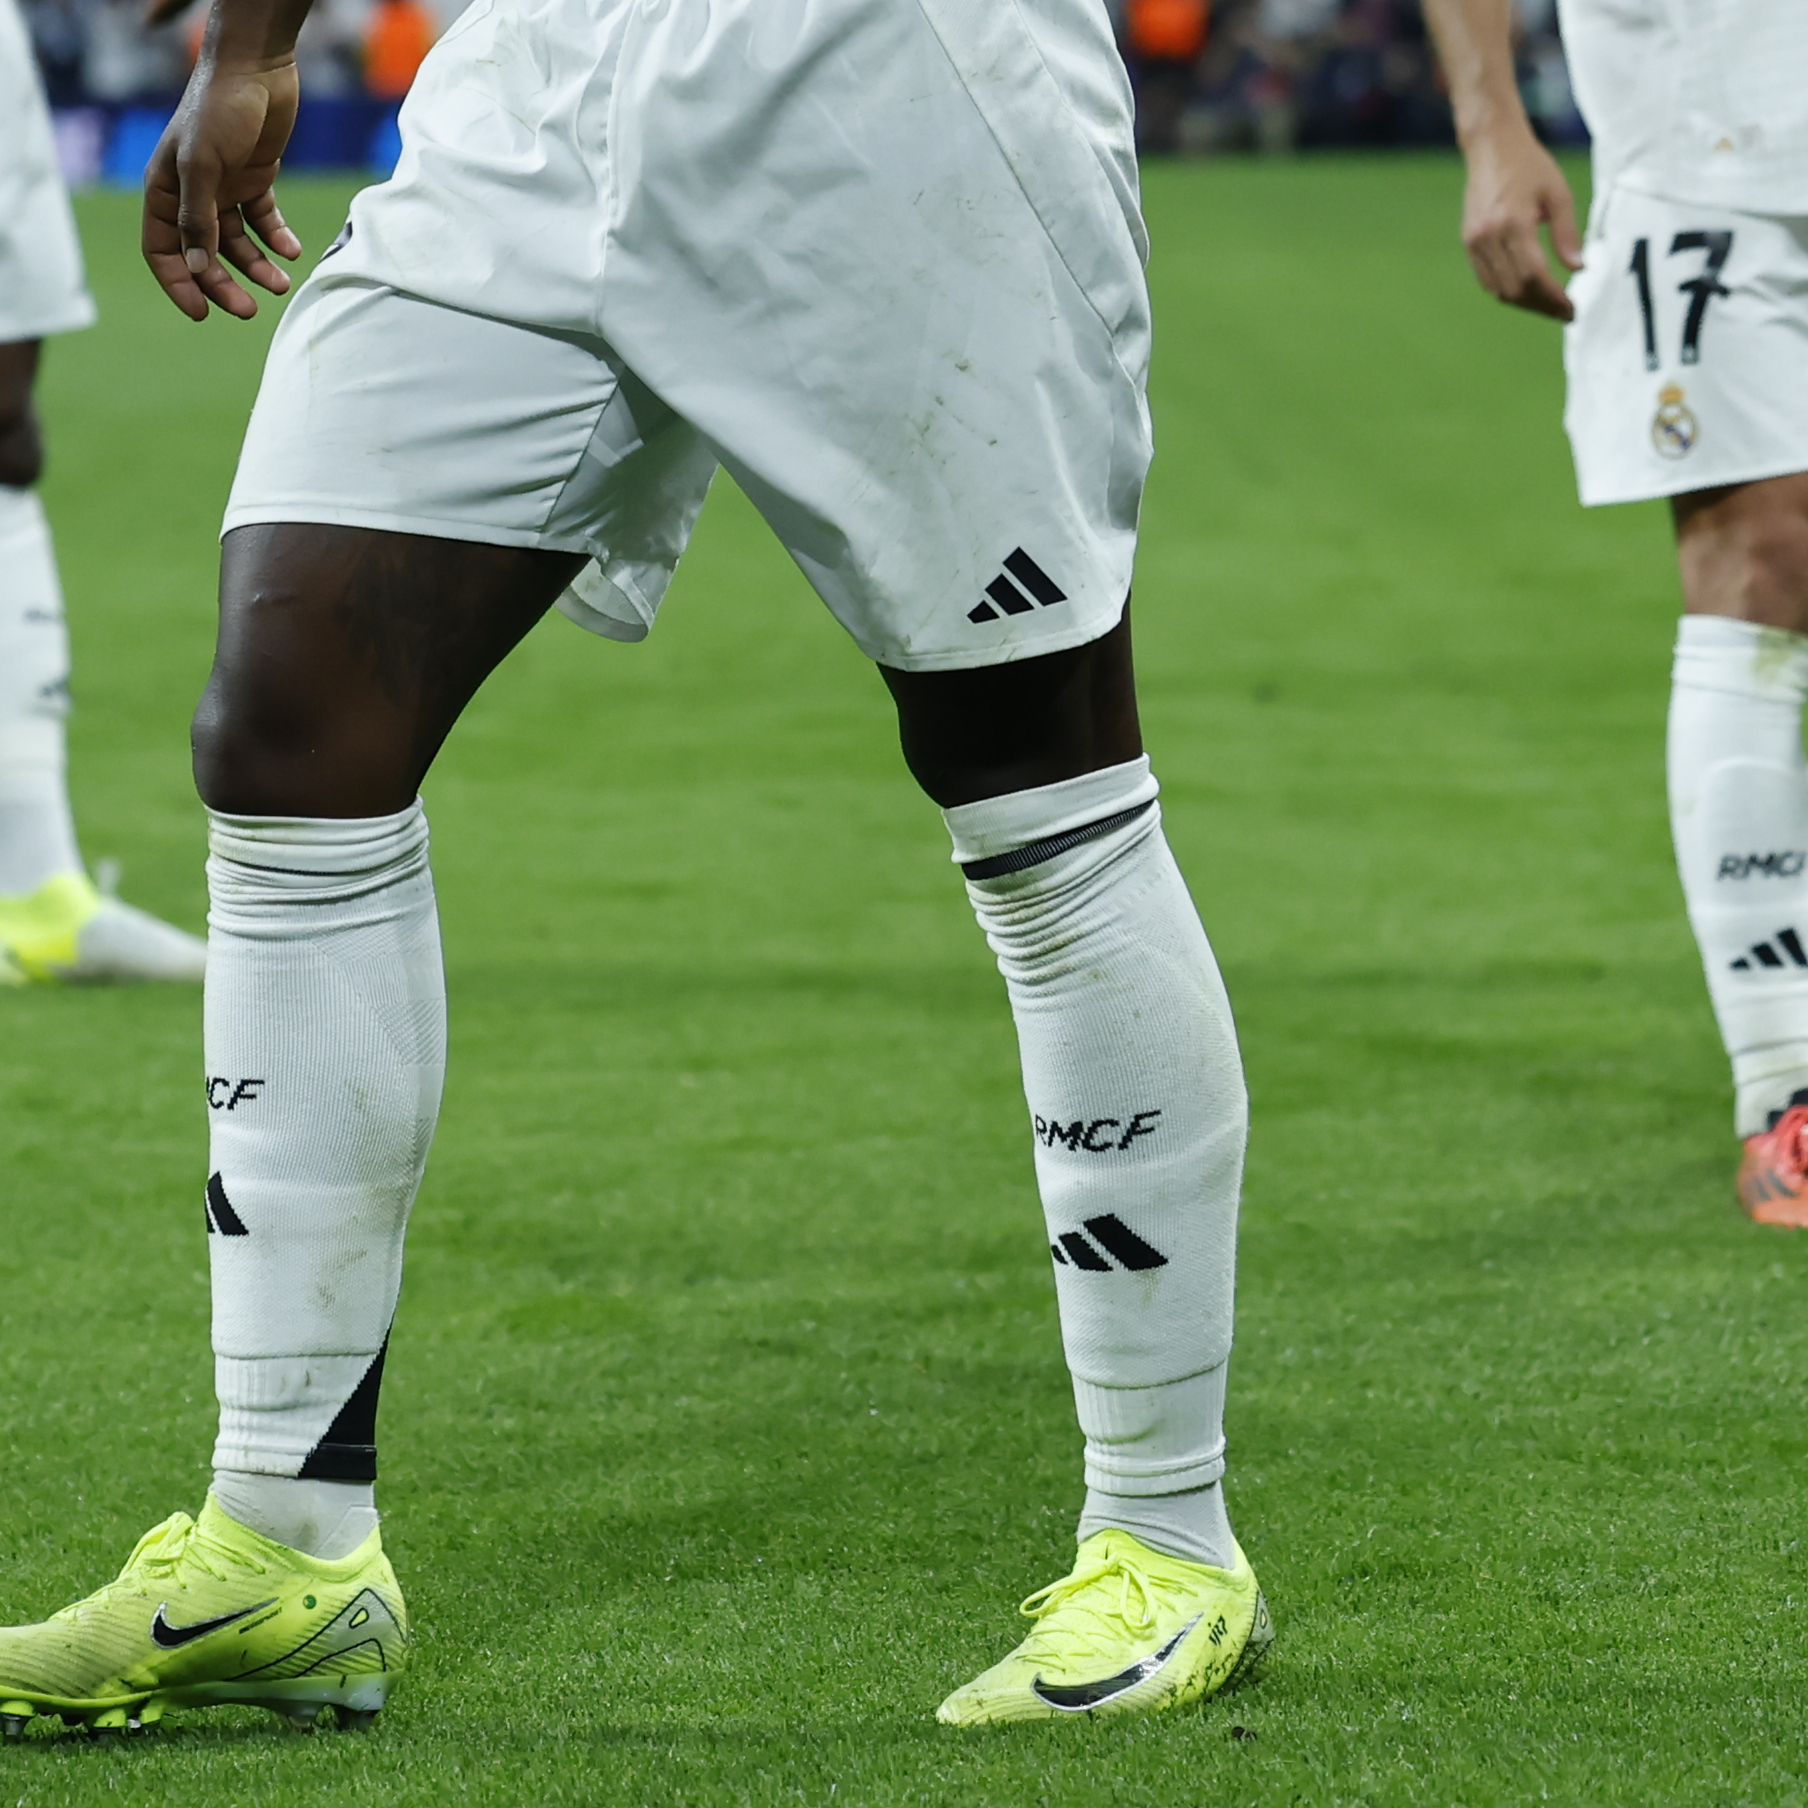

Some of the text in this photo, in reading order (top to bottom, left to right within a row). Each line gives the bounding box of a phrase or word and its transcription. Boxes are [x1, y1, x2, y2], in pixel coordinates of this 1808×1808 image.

[1629, 229, 1734, 372] 17
[206, 1076, 265, 1111] CF
[1035, 1108, 1162, 1153] RMCF
